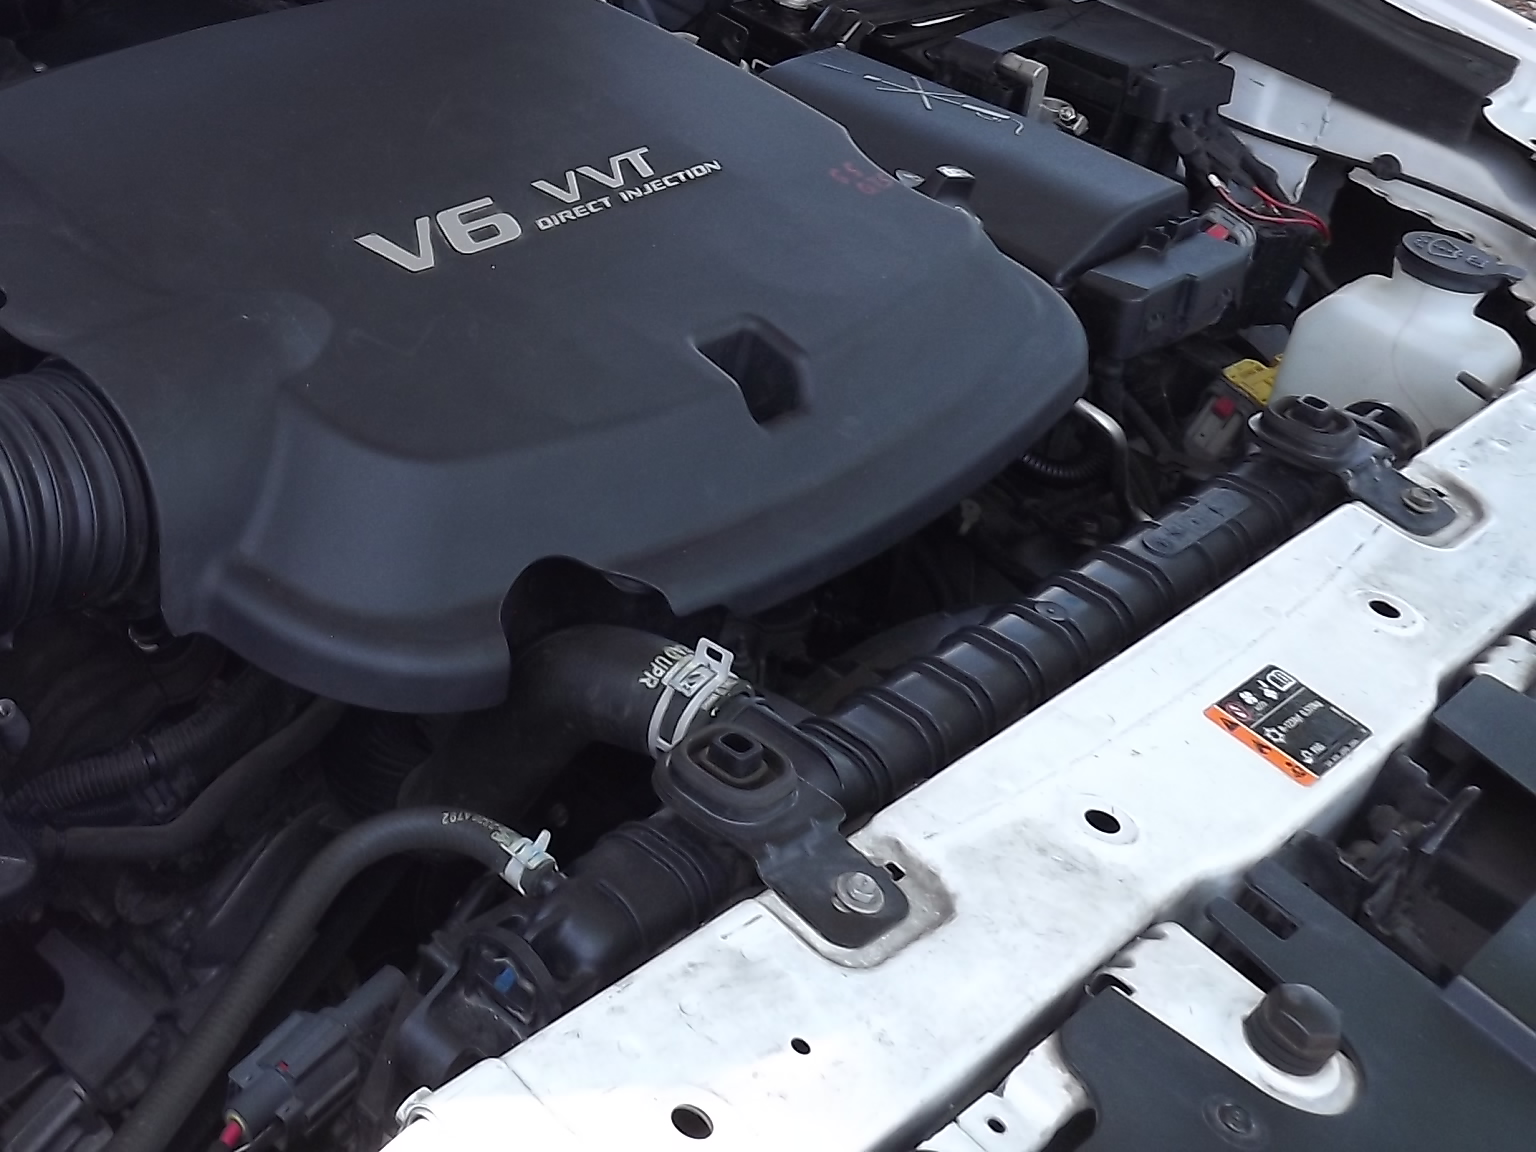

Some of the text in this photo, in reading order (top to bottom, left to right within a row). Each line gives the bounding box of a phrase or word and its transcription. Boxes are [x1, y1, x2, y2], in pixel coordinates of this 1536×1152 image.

[530, 145, 656, 204] VVT
[534, 159, 724, 232] DIRECT INJECTION
[353, 196, 523, 274] V6
